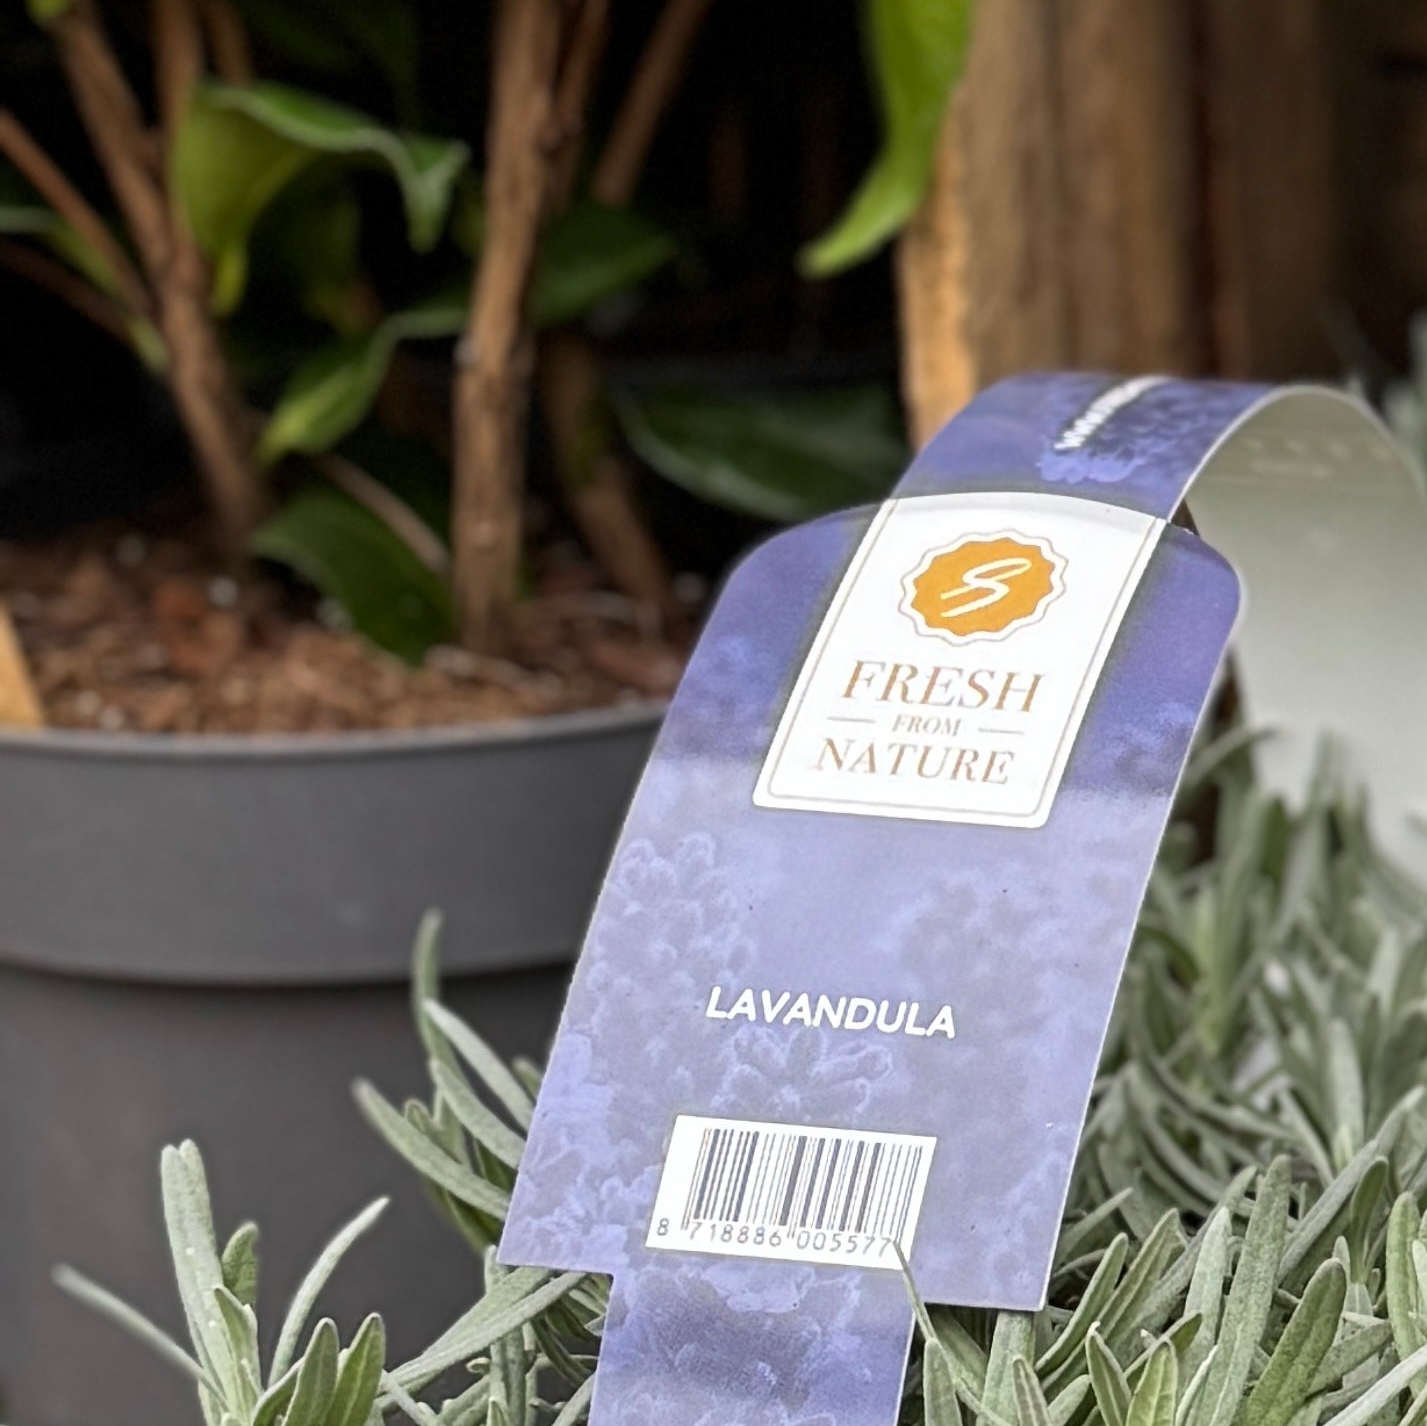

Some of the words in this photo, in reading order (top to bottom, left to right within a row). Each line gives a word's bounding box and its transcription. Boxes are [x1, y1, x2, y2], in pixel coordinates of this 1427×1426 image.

[840, 660, 1045, 713] FRESH
[891, 714, 962, 737] FROM
[812, 737, 1015, 785] NATURE
[706, 986, 956, 1038] LAVANDULA
